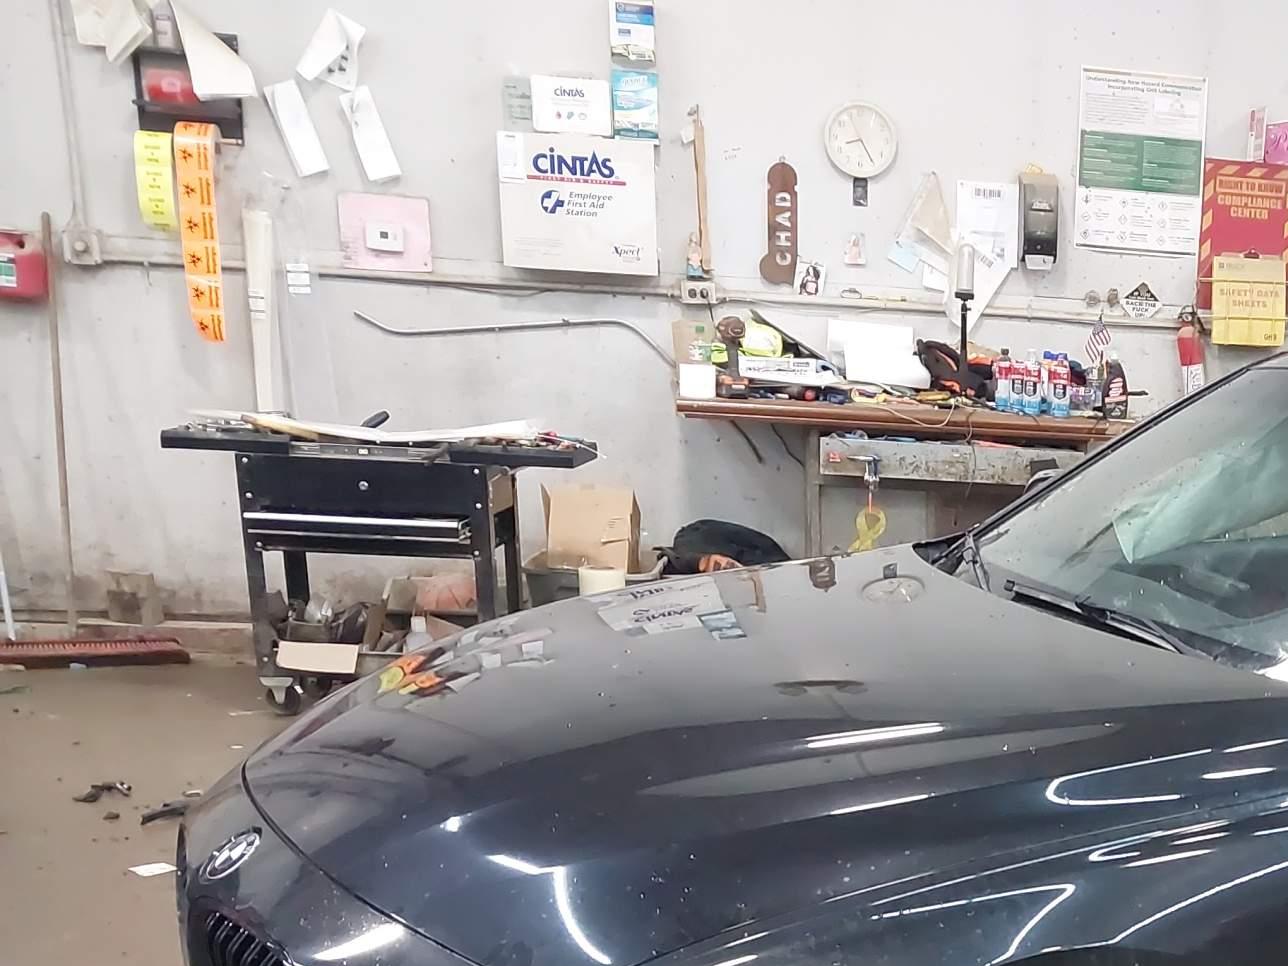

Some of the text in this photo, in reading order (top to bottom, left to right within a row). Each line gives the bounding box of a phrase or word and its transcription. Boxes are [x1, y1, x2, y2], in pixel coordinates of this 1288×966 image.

[1218, 178, 1284, 195] RIGHT TO KNOW
[569, 191, 613, 202] Employee
[1217, 194, 1284, 210] COMPLIANCE
[567, 199, 605, 209] First Aid
[565, 208, 598, 217] Station
[1230, 206, 1269, 219] CENTER
[775, 191, 792, 266] CHAD
[1257, 289, 1280, 298] DATA
